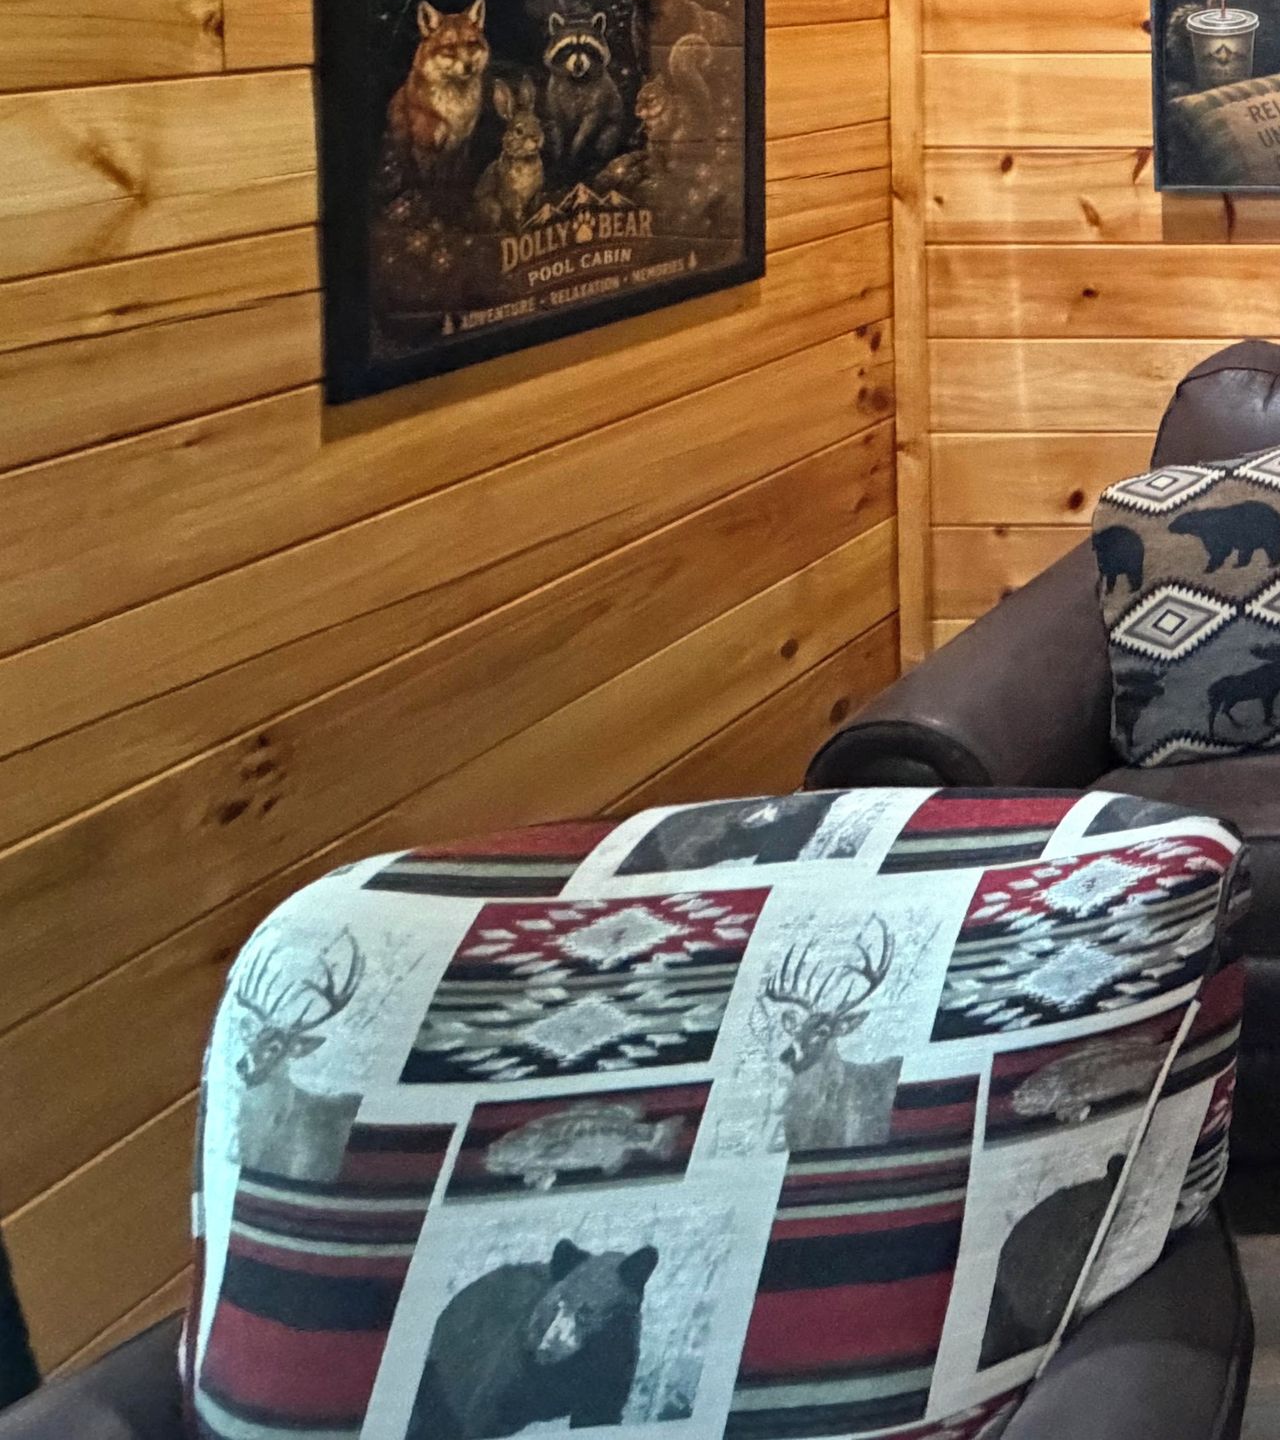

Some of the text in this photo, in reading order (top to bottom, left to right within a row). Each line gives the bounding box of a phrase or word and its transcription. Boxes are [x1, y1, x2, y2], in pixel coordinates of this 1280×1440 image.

[501, 209, 654, 273] DOLLY BEAR
[528, 247, 633, 287] POOL CABIN
[461, 295, 537, 331] ADVENTURE
